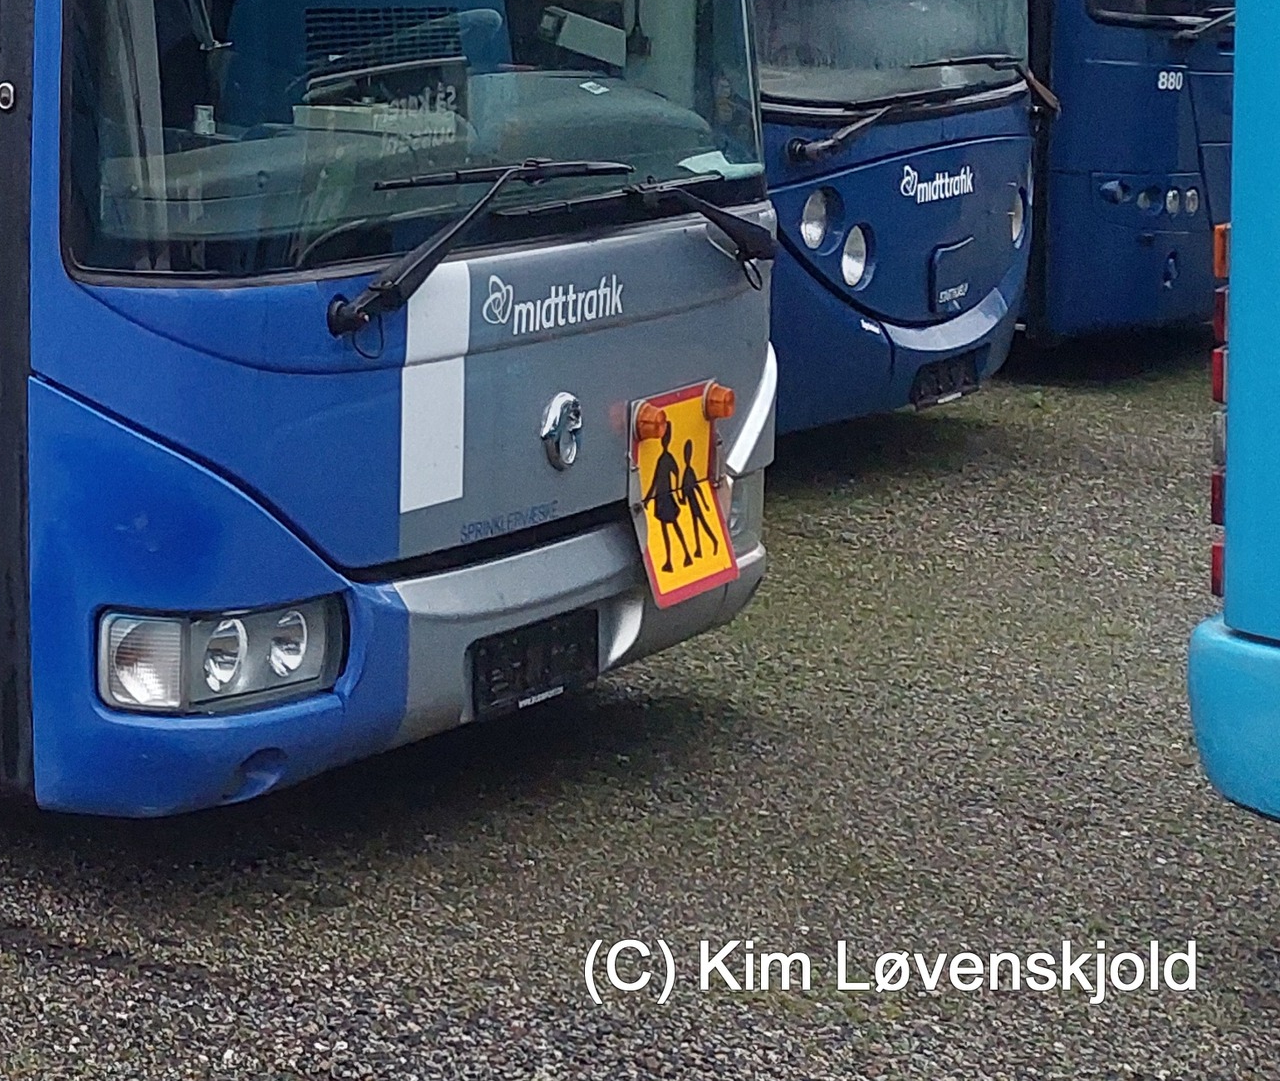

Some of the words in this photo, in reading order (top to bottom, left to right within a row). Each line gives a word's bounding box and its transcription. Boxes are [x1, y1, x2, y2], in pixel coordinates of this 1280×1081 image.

[1157, 70, 1183, 91] 880
[916, 165, 974, 204] midttrafik
[512, 273, 624, 336] midttrafik
